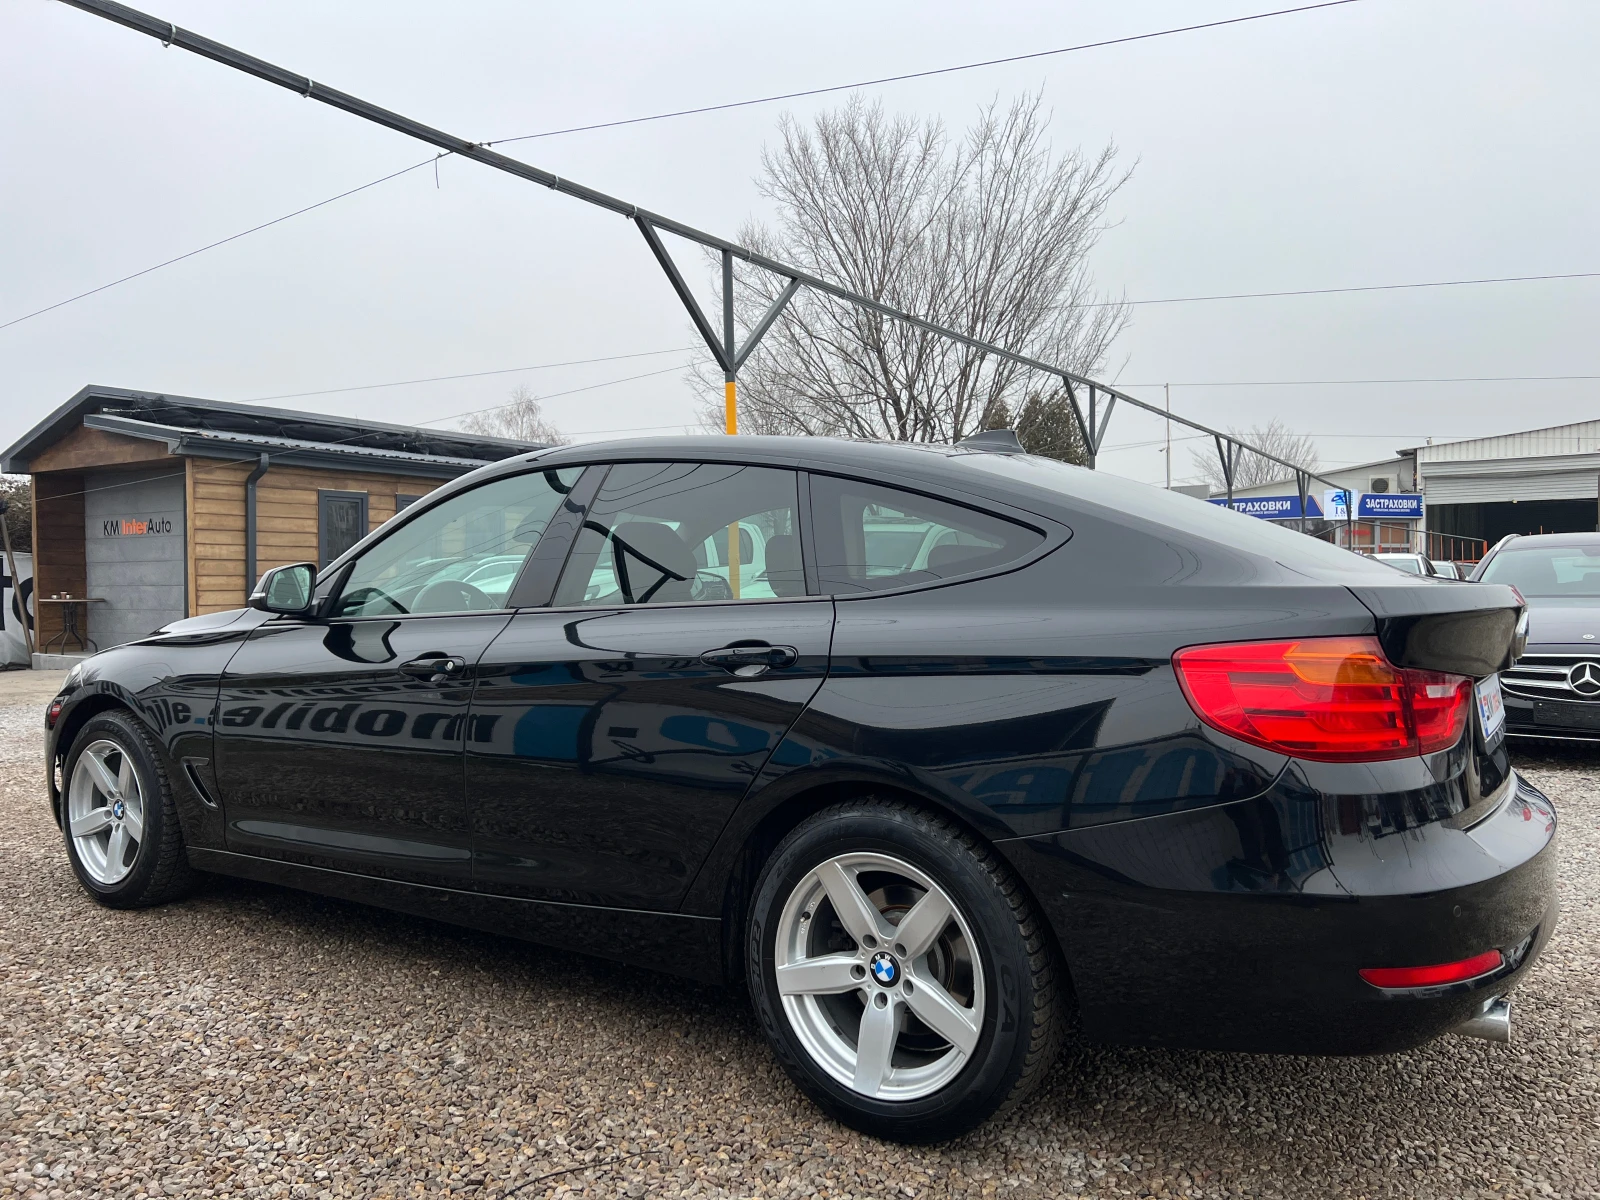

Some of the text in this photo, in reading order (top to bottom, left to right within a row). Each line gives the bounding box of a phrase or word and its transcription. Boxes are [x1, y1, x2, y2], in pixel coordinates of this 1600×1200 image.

[1220, 501, 1291, 512] ТРАХОВКИ
[1365, 498, 1418, 509] ЗАСТРАХОВКИ
[103, 516, 173, 536] KM InterAuto
